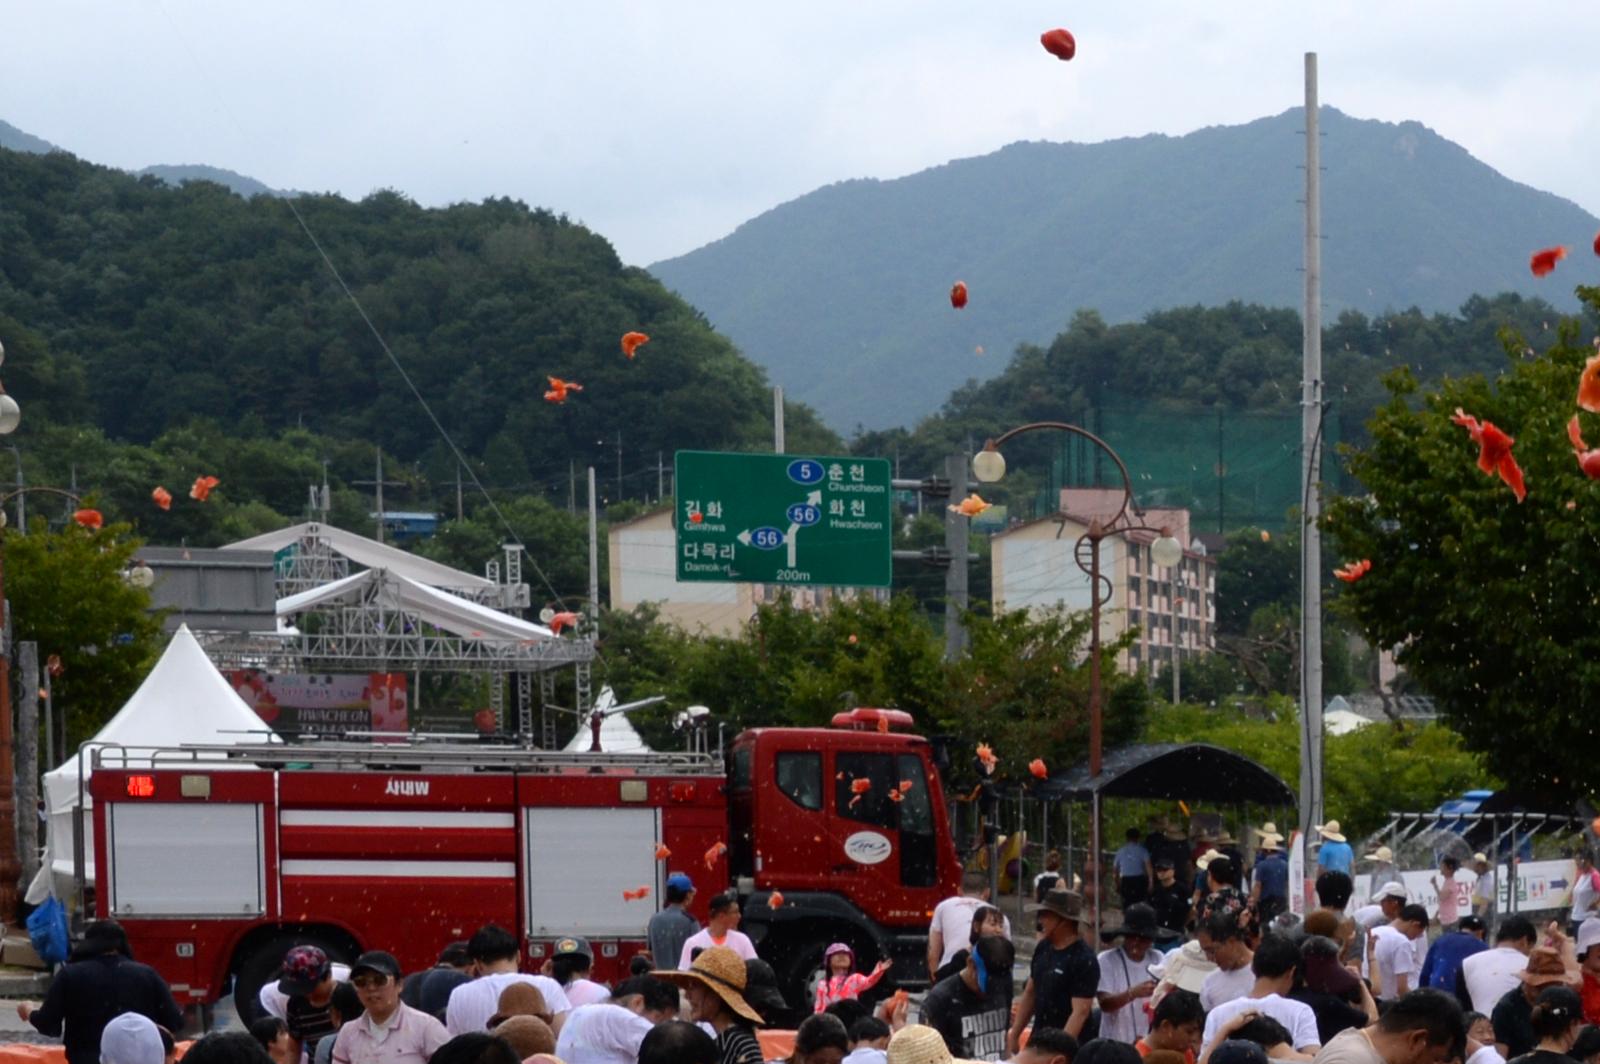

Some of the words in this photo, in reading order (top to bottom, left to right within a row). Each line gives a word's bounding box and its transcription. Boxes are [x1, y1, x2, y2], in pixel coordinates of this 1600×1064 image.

[801, 464, 811, 480] 5
[828, 464, 865, 482] 춘천
[828, 482, 885, 493] Chuncheon
[794, 508, 815, 523] 56
[828, 499, 866, 518] 화천
[830, 519, 883, 530] Hwacheon
[757, 531, 778, 546] 56
[684, 543, 735, 561] 다목리
[776, 569, 811, 581] 200m
